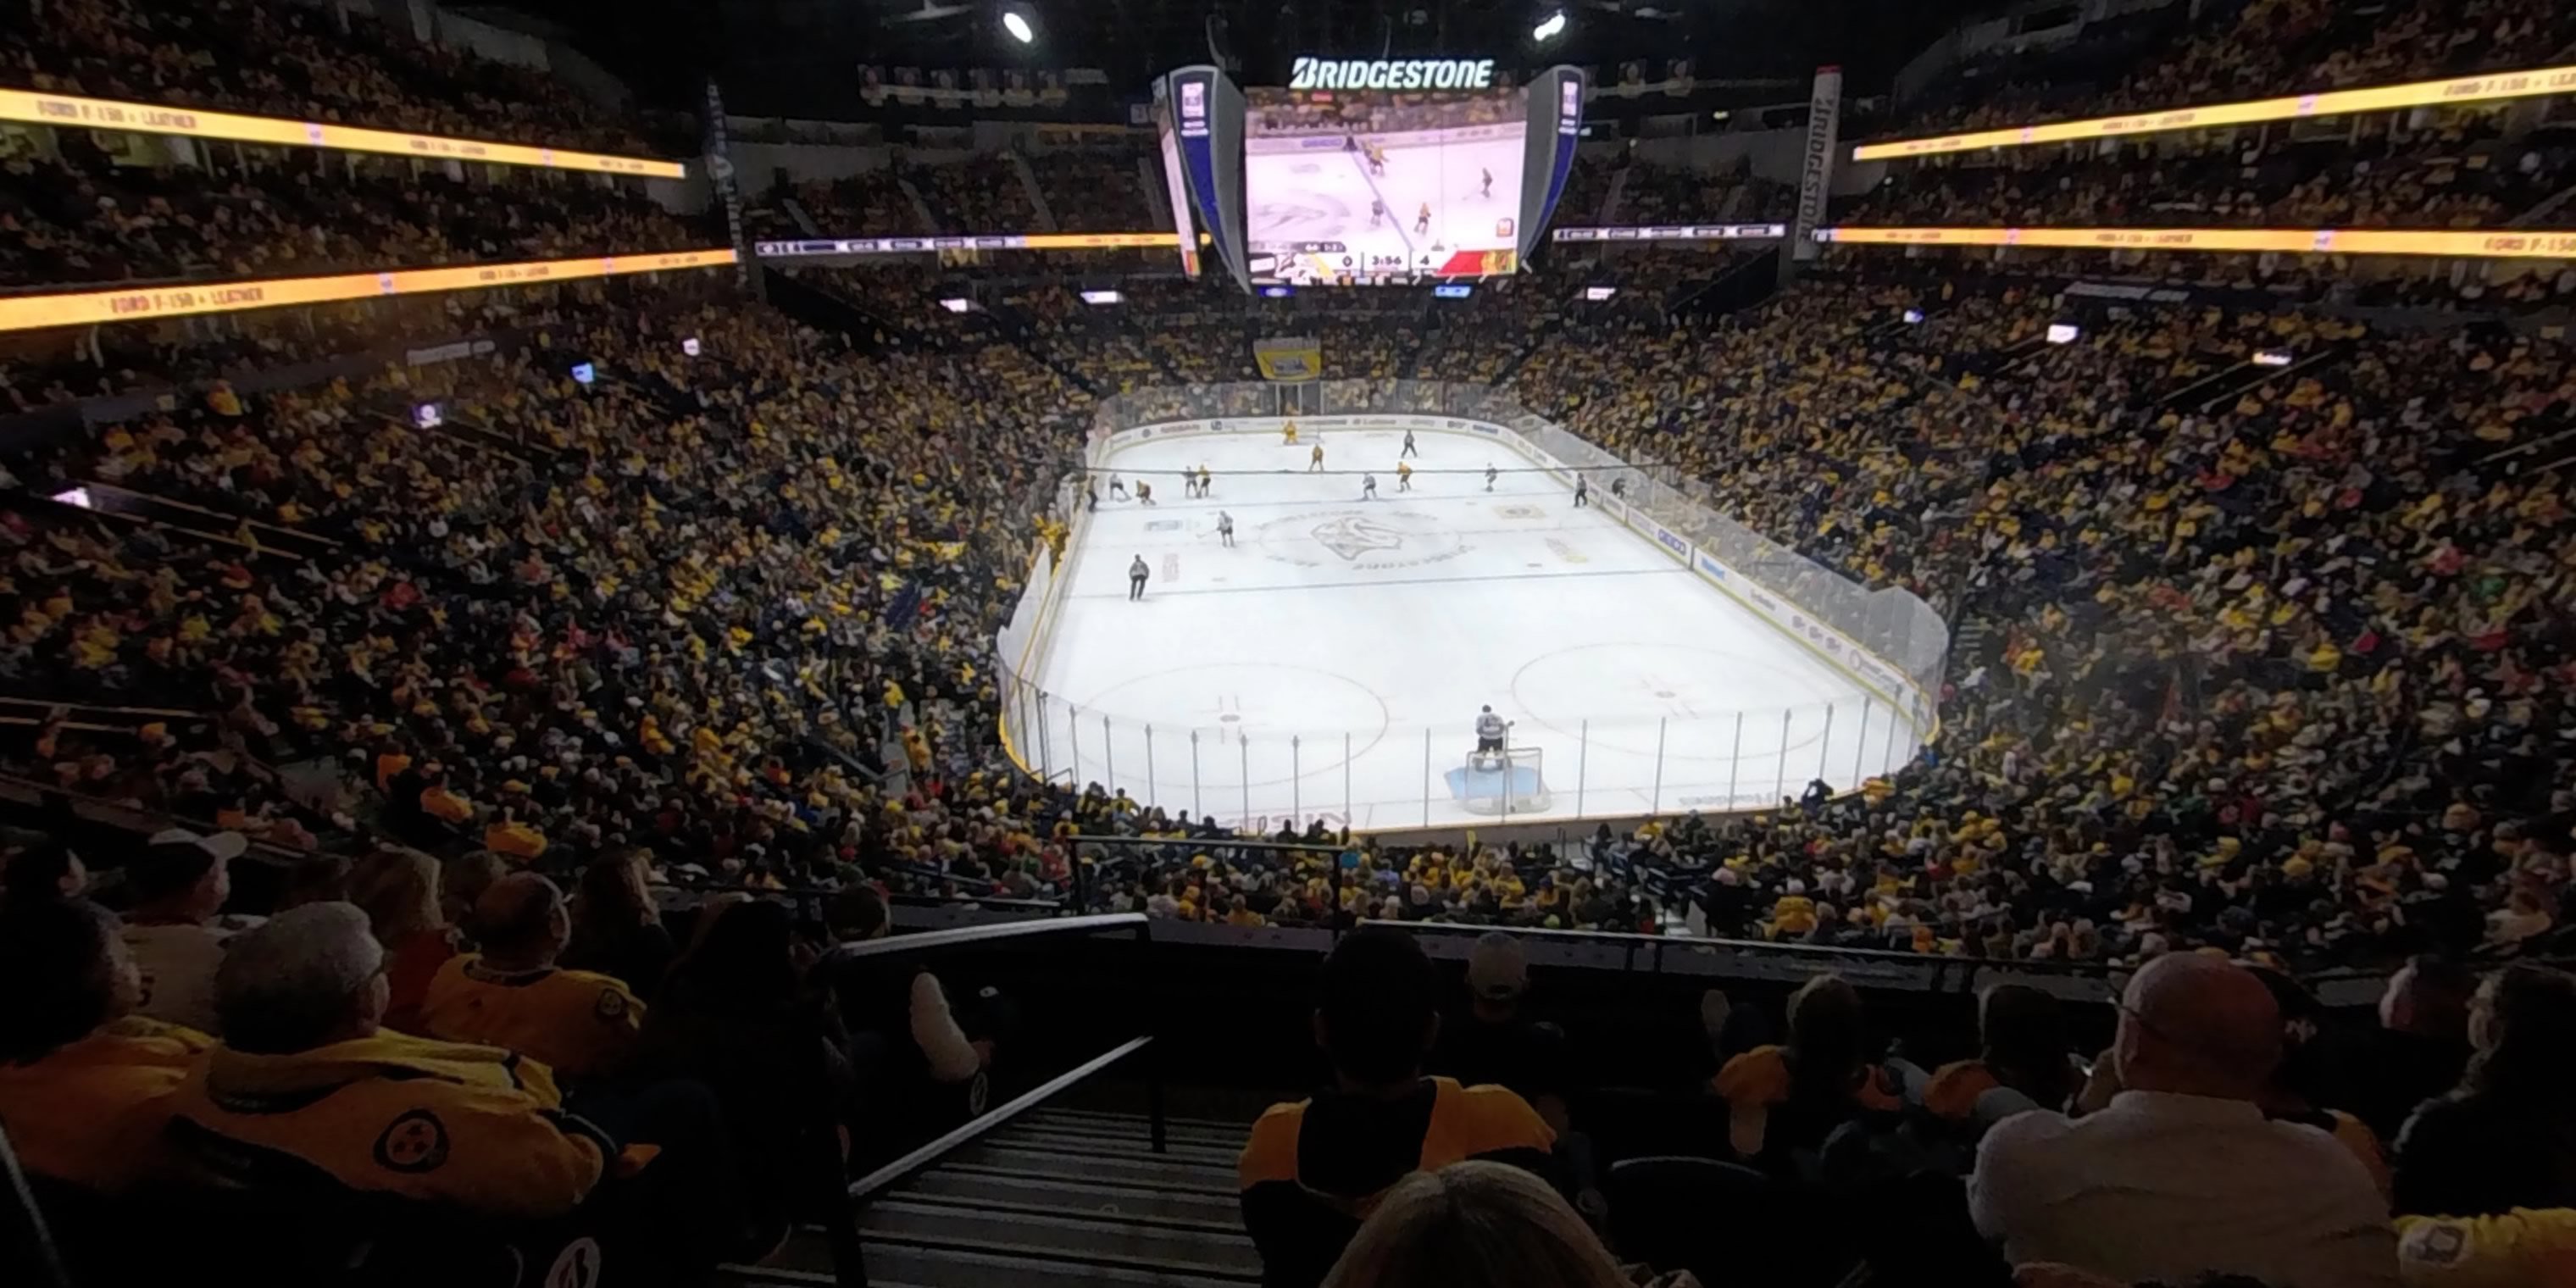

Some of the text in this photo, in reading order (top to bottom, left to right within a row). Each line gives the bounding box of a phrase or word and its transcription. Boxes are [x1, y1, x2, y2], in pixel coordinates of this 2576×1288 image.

[1289, 57, 1494, 89] BRIDGESTONE
[1799, 98, 1835, 243] BRIDGESTONE
[1342, 255, 1353, 267] 0
[1419, 255, 1430, 265] 4
